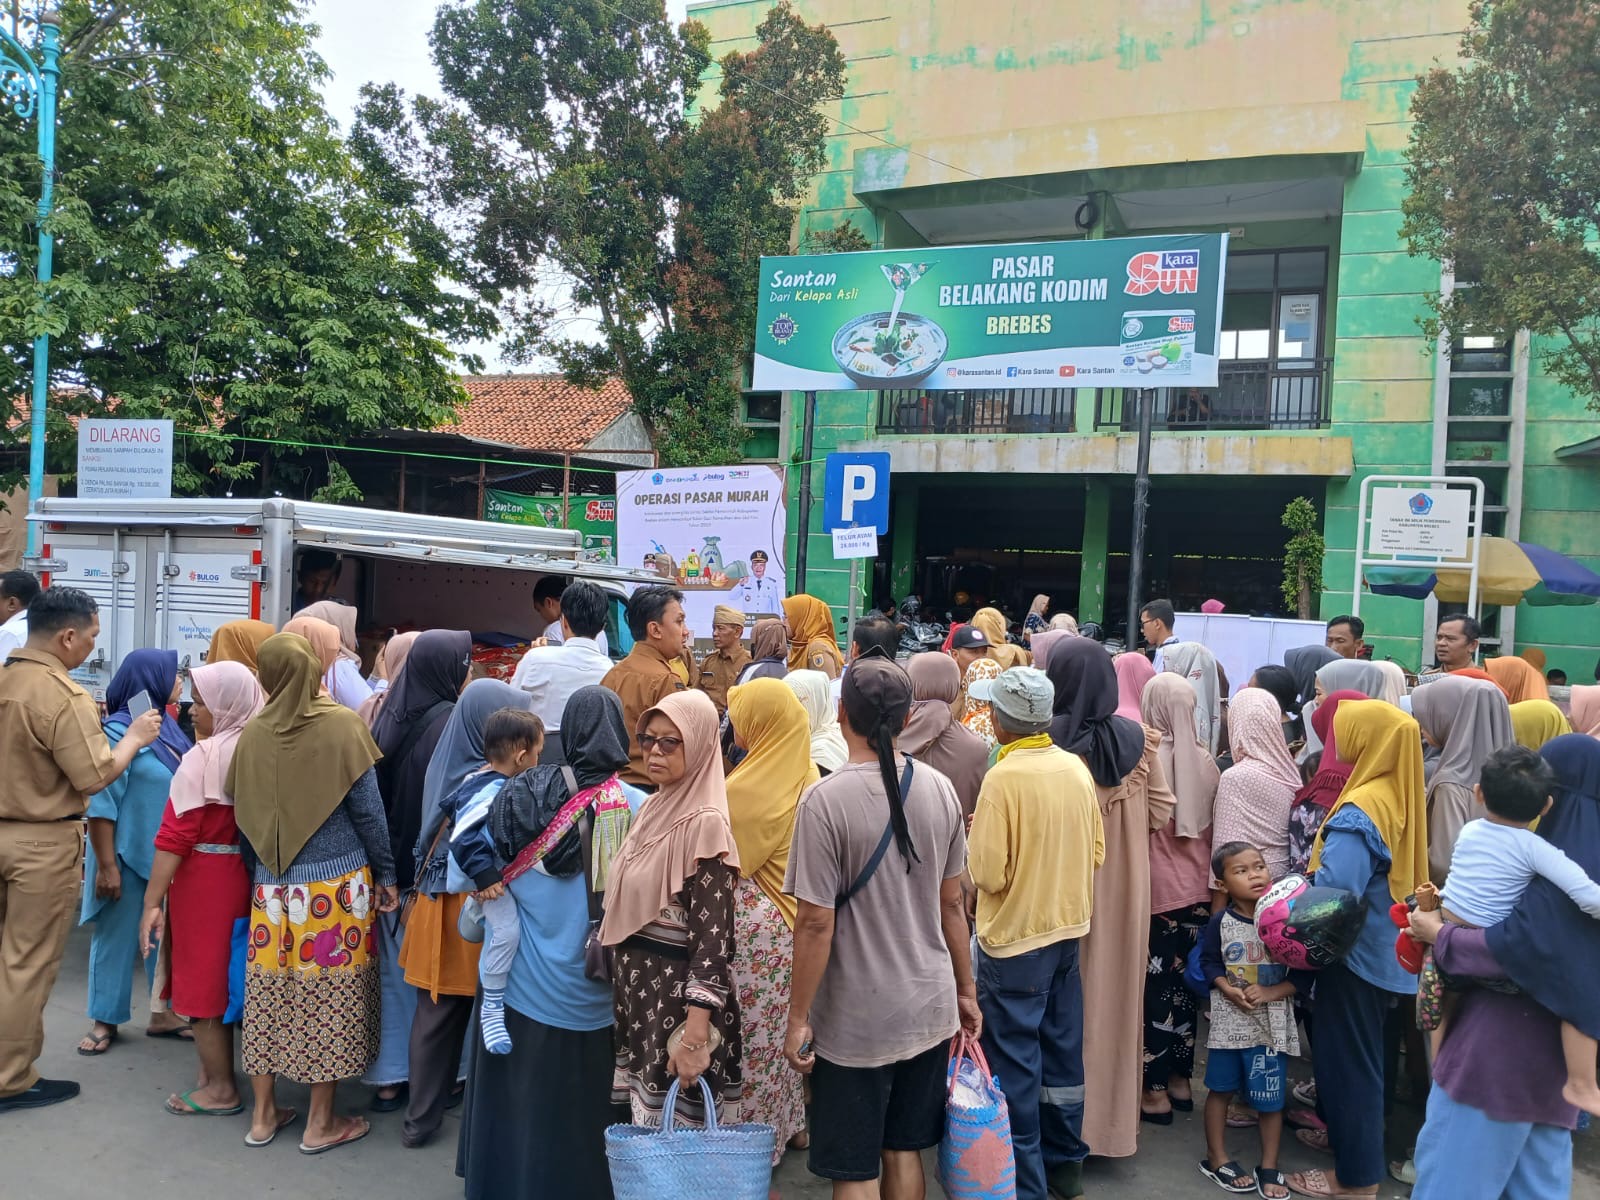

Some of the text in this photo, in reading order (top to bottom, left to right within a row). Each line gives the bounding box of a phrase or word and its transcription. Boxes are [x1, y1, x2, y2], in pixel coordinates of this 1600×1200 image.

[991, 255, 1055, 279] PASAR
[1165, 254, 1194, 268] kara
[770, 270, 837, 288] Santan
[1124, 252, 1197, 295] SUN
[769, 288, 859, 304] Dari Kelapa Asli
[939, 278, 1108, 306] BELAKANG KODIM
[986, 314, 1052, 335] BREBES
[1018, 367, 1032, 375] Kara
[1033, 367, 1054, 375] Santan
[1093, 366, 1115, 374] Santan
[90, 427, 161, 442] DILARANG
[634, 490, 769, 506] OPERASI PASAR MURAH
[841, 464, 876, 521] P
[488, 500, 523, 513] Santan
[857, 532, 873, 540] AYAM
[197, 573, 219, 581] BULOG
[1227, 1034, 1251, 1042] GUCI
